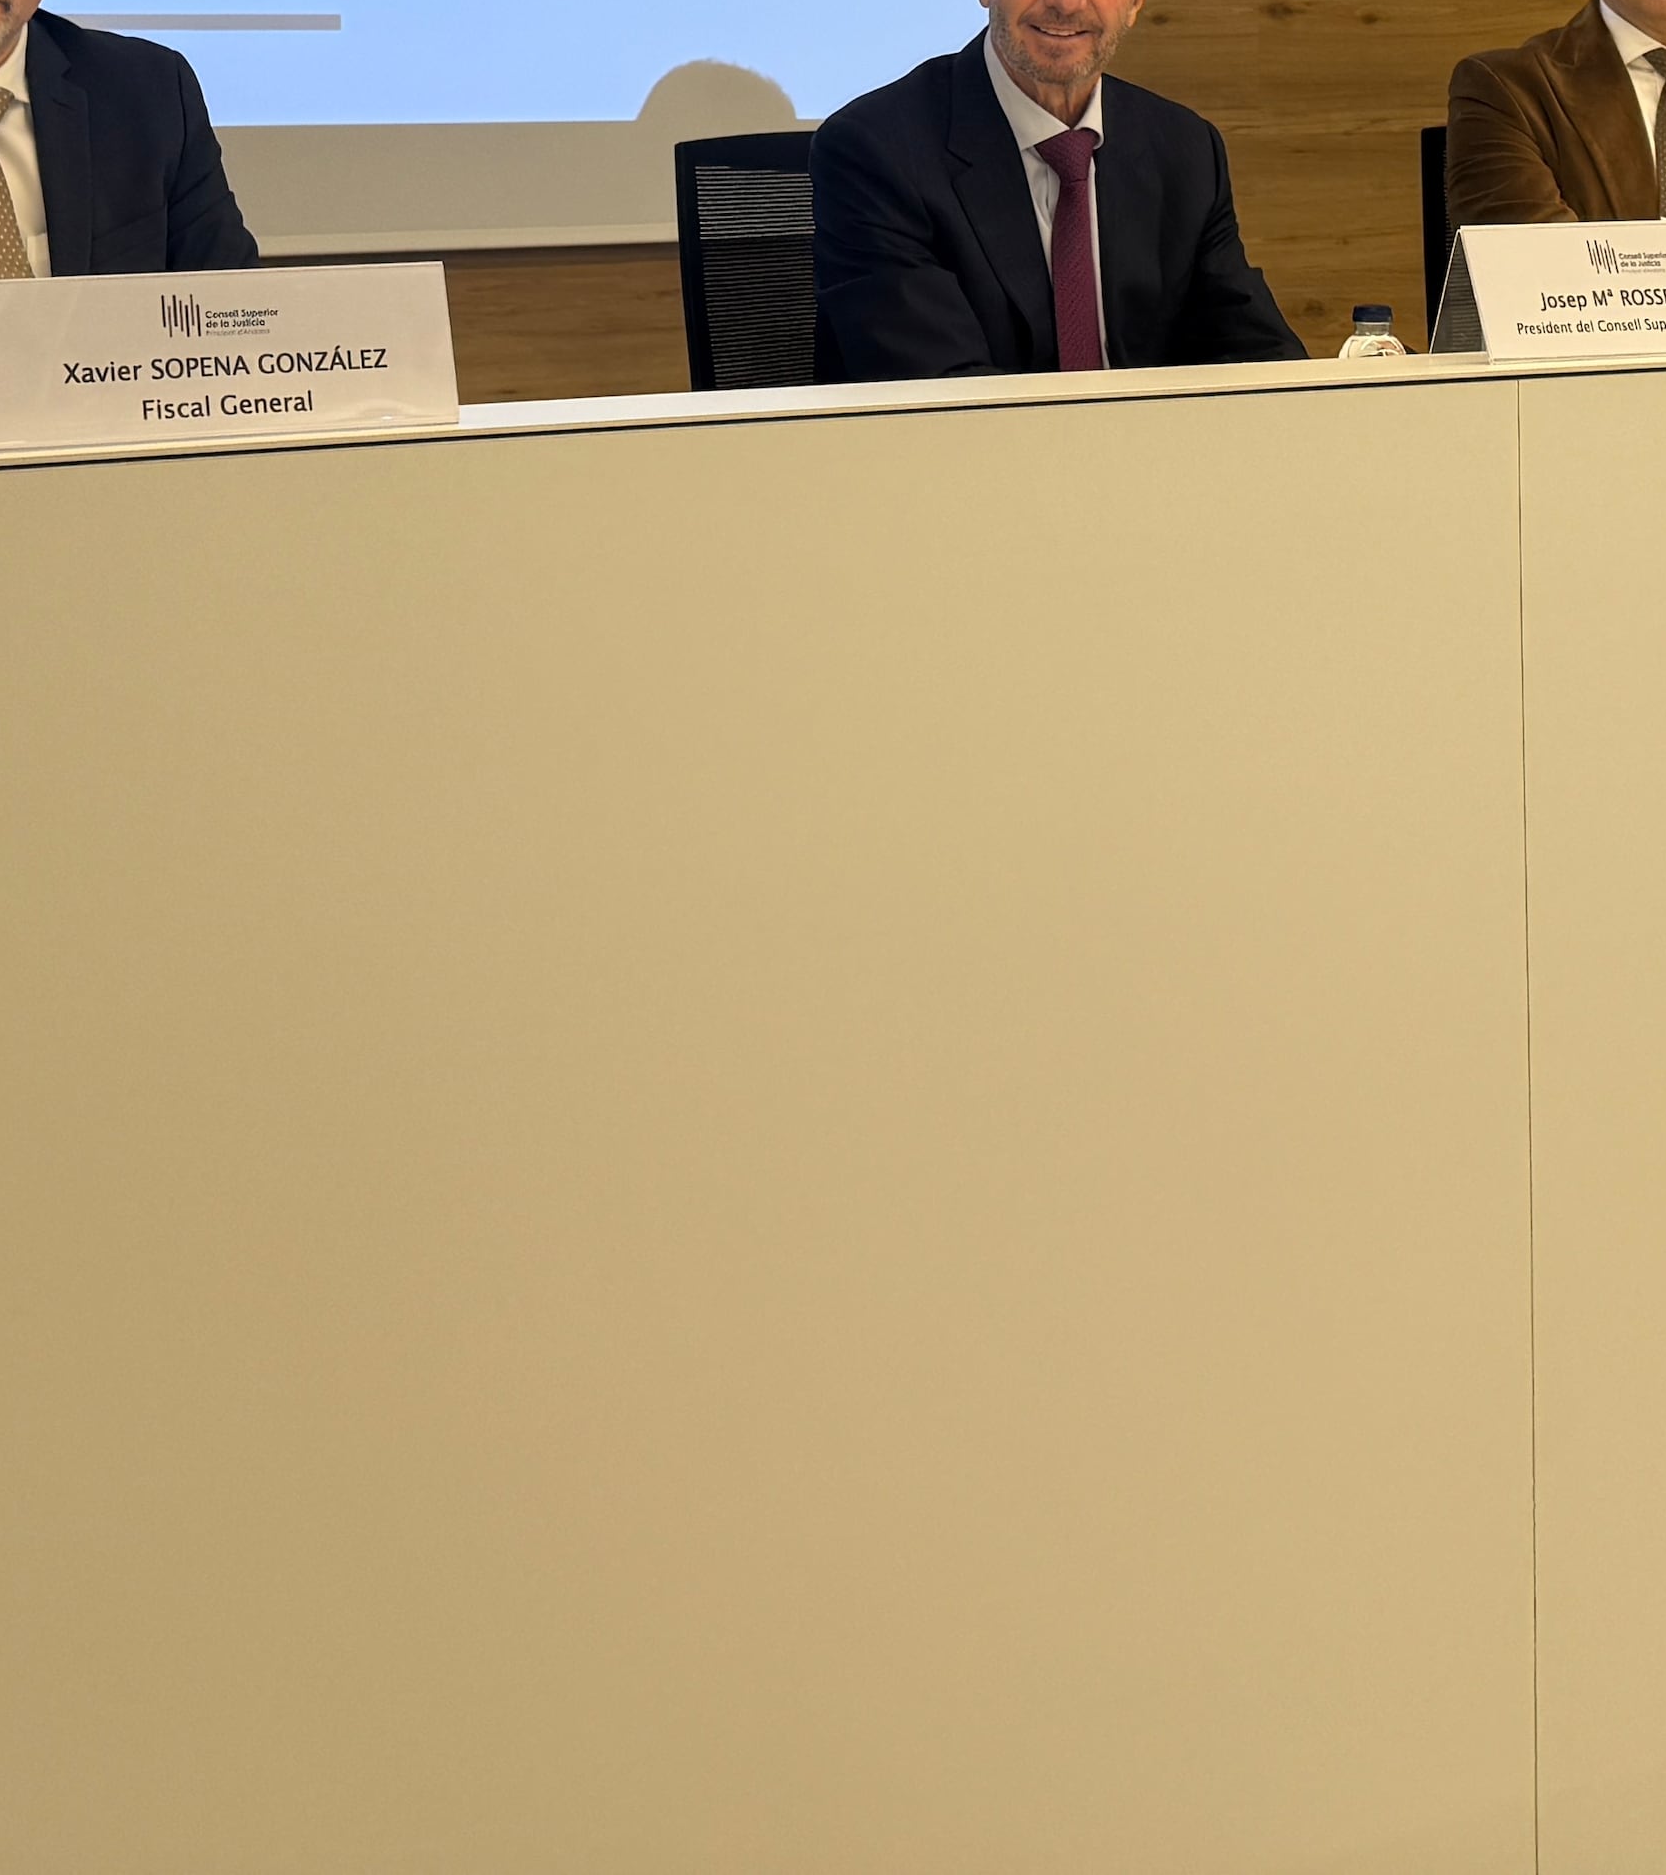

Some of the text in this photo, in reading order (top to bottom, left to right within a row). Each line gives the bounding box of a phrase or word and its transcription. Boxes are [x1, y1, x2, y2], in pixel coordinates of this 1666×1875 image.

[1540, 292, 1587, 311] Josep
[1592, 288, 1613, 307] Mª
[205, 308, 279, 319] Consell Superior
[206, 319, 219, 328] de
[220, 319, 230, 328] la
[1517, 321, 1573, 335] President
[1576, 319, 1594, 333] del
[1597, 318, 1642, 332] Consell
[63, 345, 389, 385] Xavier SOPENA GONZÁLEZ
[142, 390, 313, 421] Fiscal General
